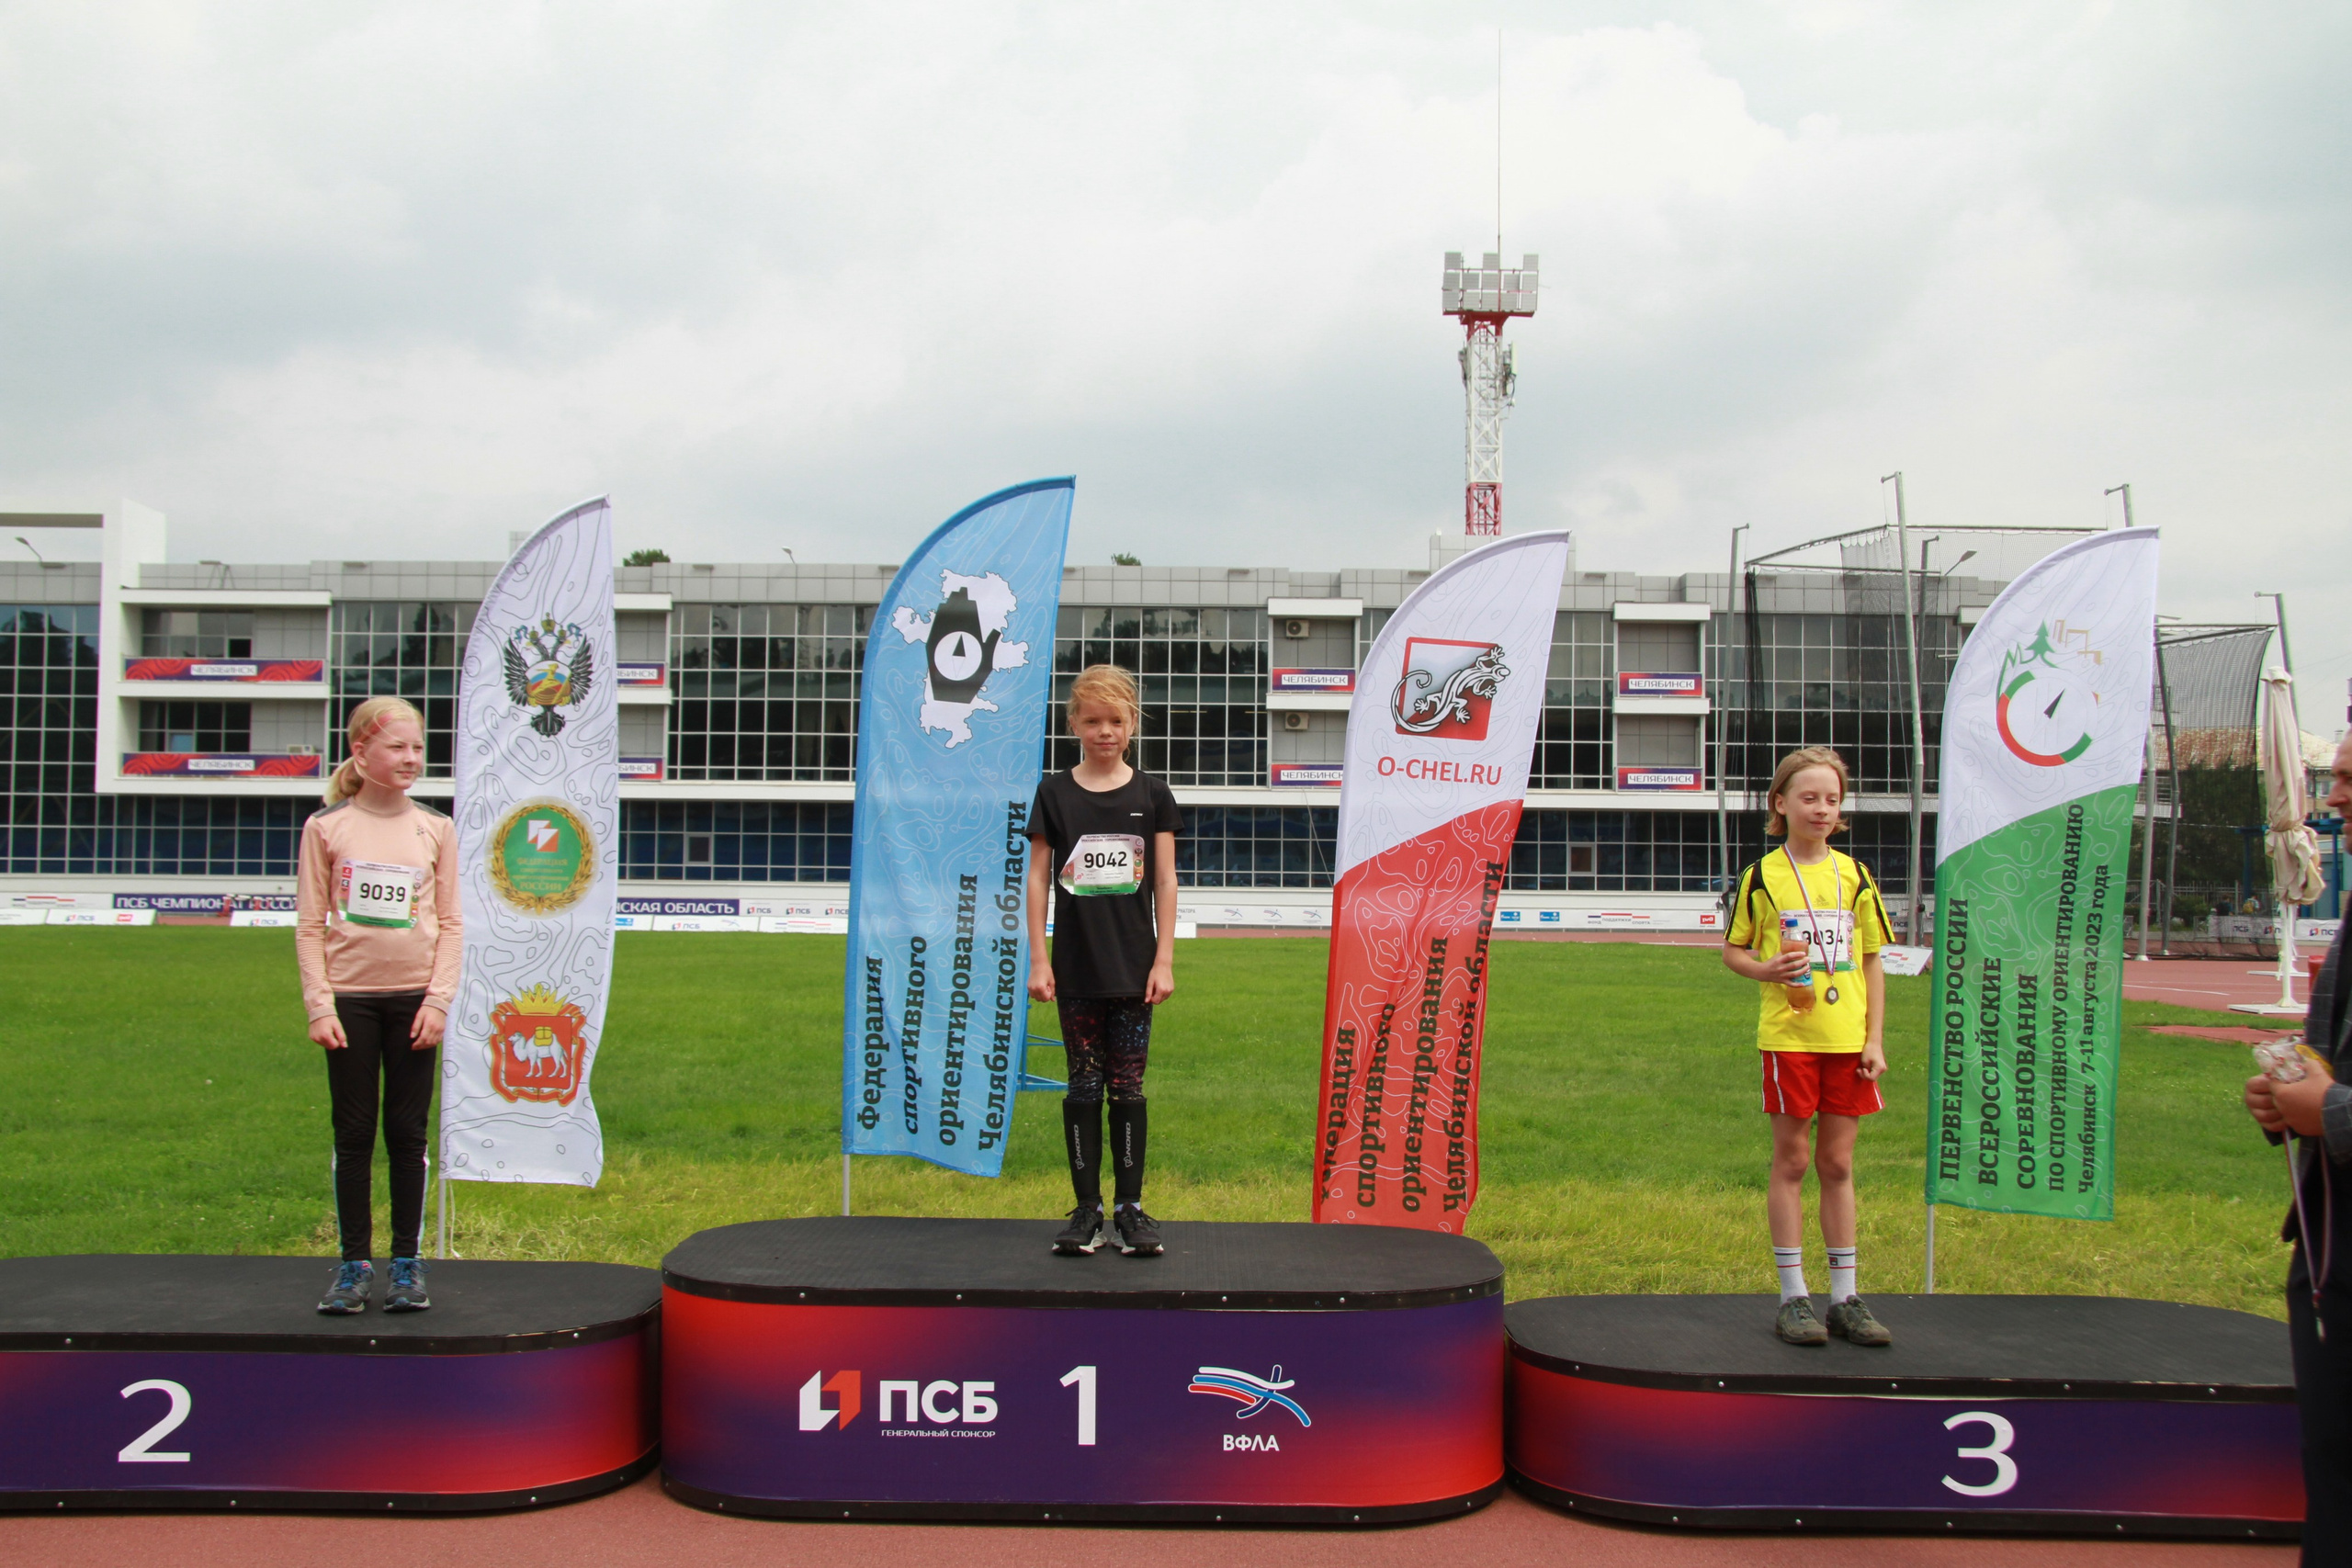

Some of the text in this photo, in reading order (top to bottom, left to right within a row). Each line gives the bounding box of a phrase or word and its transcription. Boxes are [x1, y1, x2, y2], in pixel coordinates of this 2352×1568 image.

[191, 665, 255, 674] ЧЕЛЯБИНСК
[1283, 675, 1346, 684] ЧЕЛЯБИНСК
[1630, 680, 1693, 688] ЧЕЛЯБИНСК
[188, 761, 254, 769] ЧЕЛЯБИНСК
[1377, 756, 1502, 785] O-CHEL.RU
[1629, 774, 1692, 783] ЧЕЛЯБИНСК
[359, 882, 406, 903] 9039
[519, 882, 562, 891] РОССИИ
[1084, 852, 1127, 869] 9042
[116, 897, 149, 908] ПСБ
[664, 902, 735, 914] ОБЛАСТЬ
[937, 874, 978, 1146] ориентирования
[978, 801, 1027, 1151] Челябинской области
[2049, 804, 2085, 1192] ПО СПОРТИВНОМУ ОРИЕНТИРОВАНИЮ
[856, 956, 890, 1130] Федерация
[900, 936, 928, 1134] спортивного
[1443, 862, 1504, 1212] Челябинской области
[1939, 897, 1968, 1181] ПЕРВЕНСТВО РОССИИ
[2077, 864, 2110, 1194] Челябинск 7-11 августа 2023 года
[1357, 1004, 1396, 1208] спортивного
[1402, 937, 1448, 1213] ориентирования
[1974, 957, 2002, 1186] ВСЕРОССИЙСКИЕ
[2015, 974, 2039, 1190] СОРЕВНОВАНИЯ
[119, 1379, 191, 1462] 2
[879, 1380, 999, 1424] ПСБ
[881, 1427, 996, 1438] ГЕНЕРАЛЬНЫЙ СПОНСОР
[1059, 1365, 1096, 1445] 1
[1223, 1434, 1280, 1451] ВФЛА
[1941, 1411, 2018, 1497] 3
